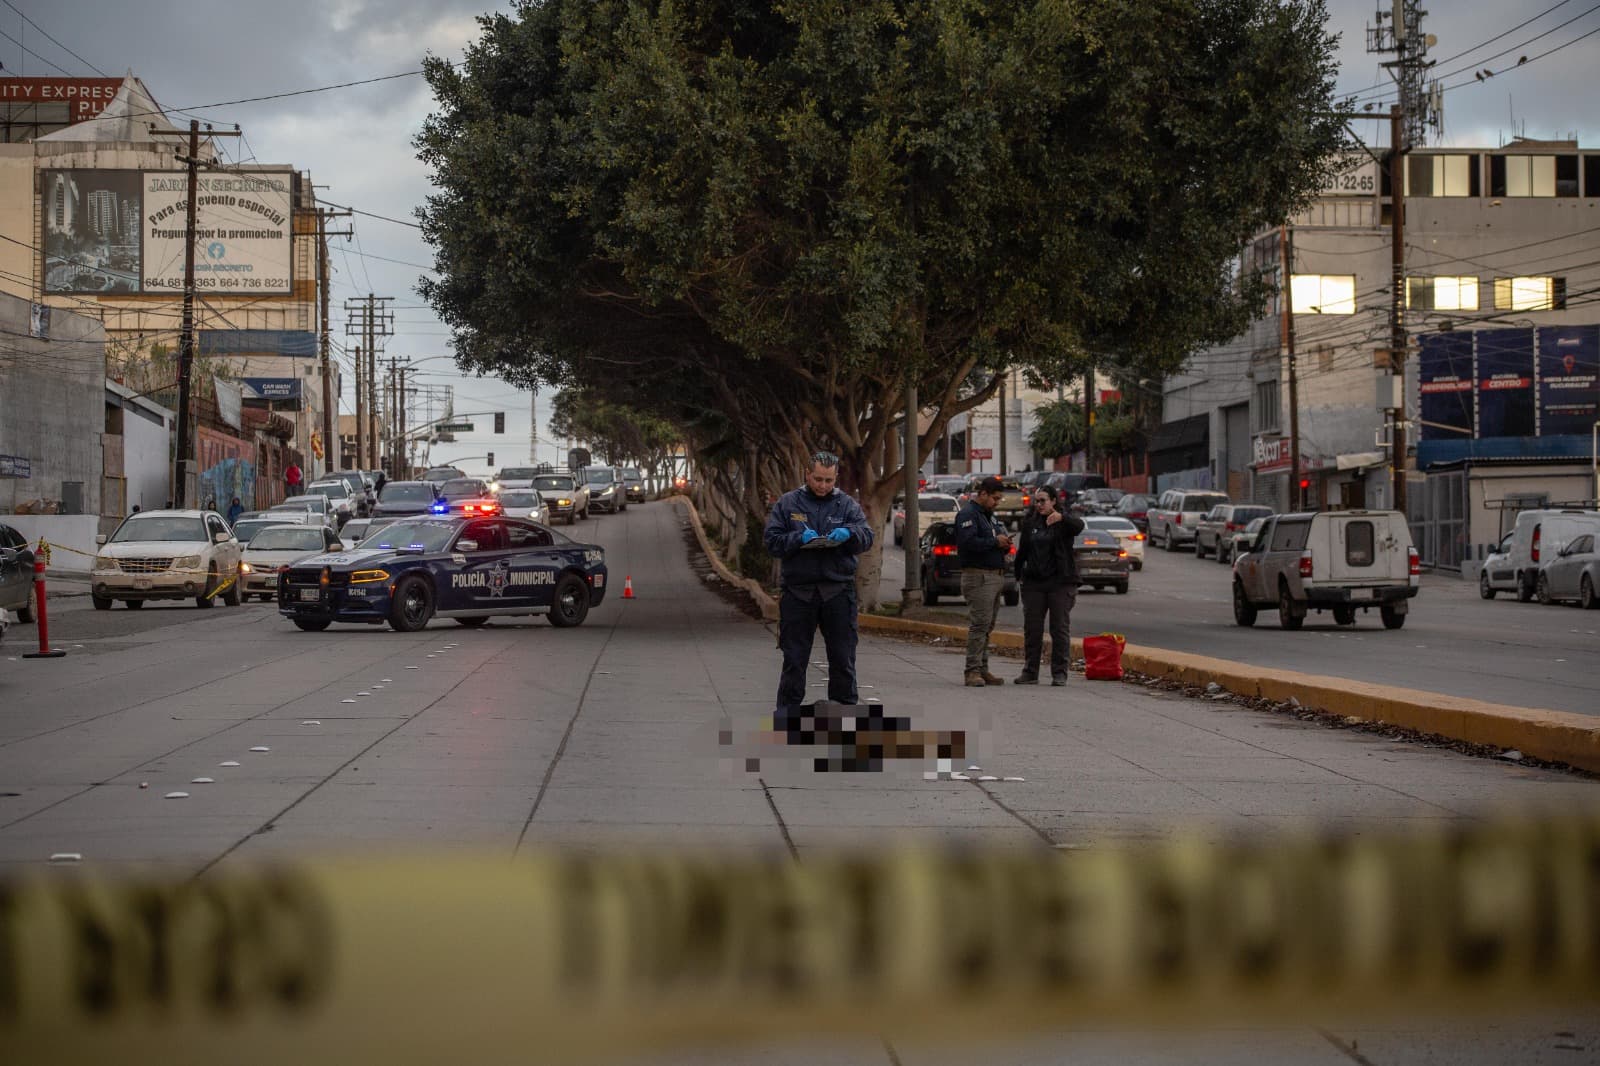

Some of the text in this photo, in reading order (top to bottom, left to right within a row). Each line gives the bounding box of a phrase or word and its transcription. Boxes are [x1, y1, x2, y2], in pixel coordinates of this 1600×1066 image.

[2, 85, 120, 98] ITY EXPRES
[79, 101, 107, 113] PL
[149, 178, 210, 192] JARN
[149, 195, 286, 226] Para es evento especial
[152, 228, 187, 240] Pregun
[217, 228, 227, 239] la
[228, 228, 283, 241] promocion
[145, 278, 164, 287] 664
[193, 278, 216, 287] 363
[220, 278, 239, 287] 664
[243, 278, 262, 287] 736
[264, 278, 289, 287] 8221
[452, 571, 556, 588] POLICÍA MUNICIPAL
